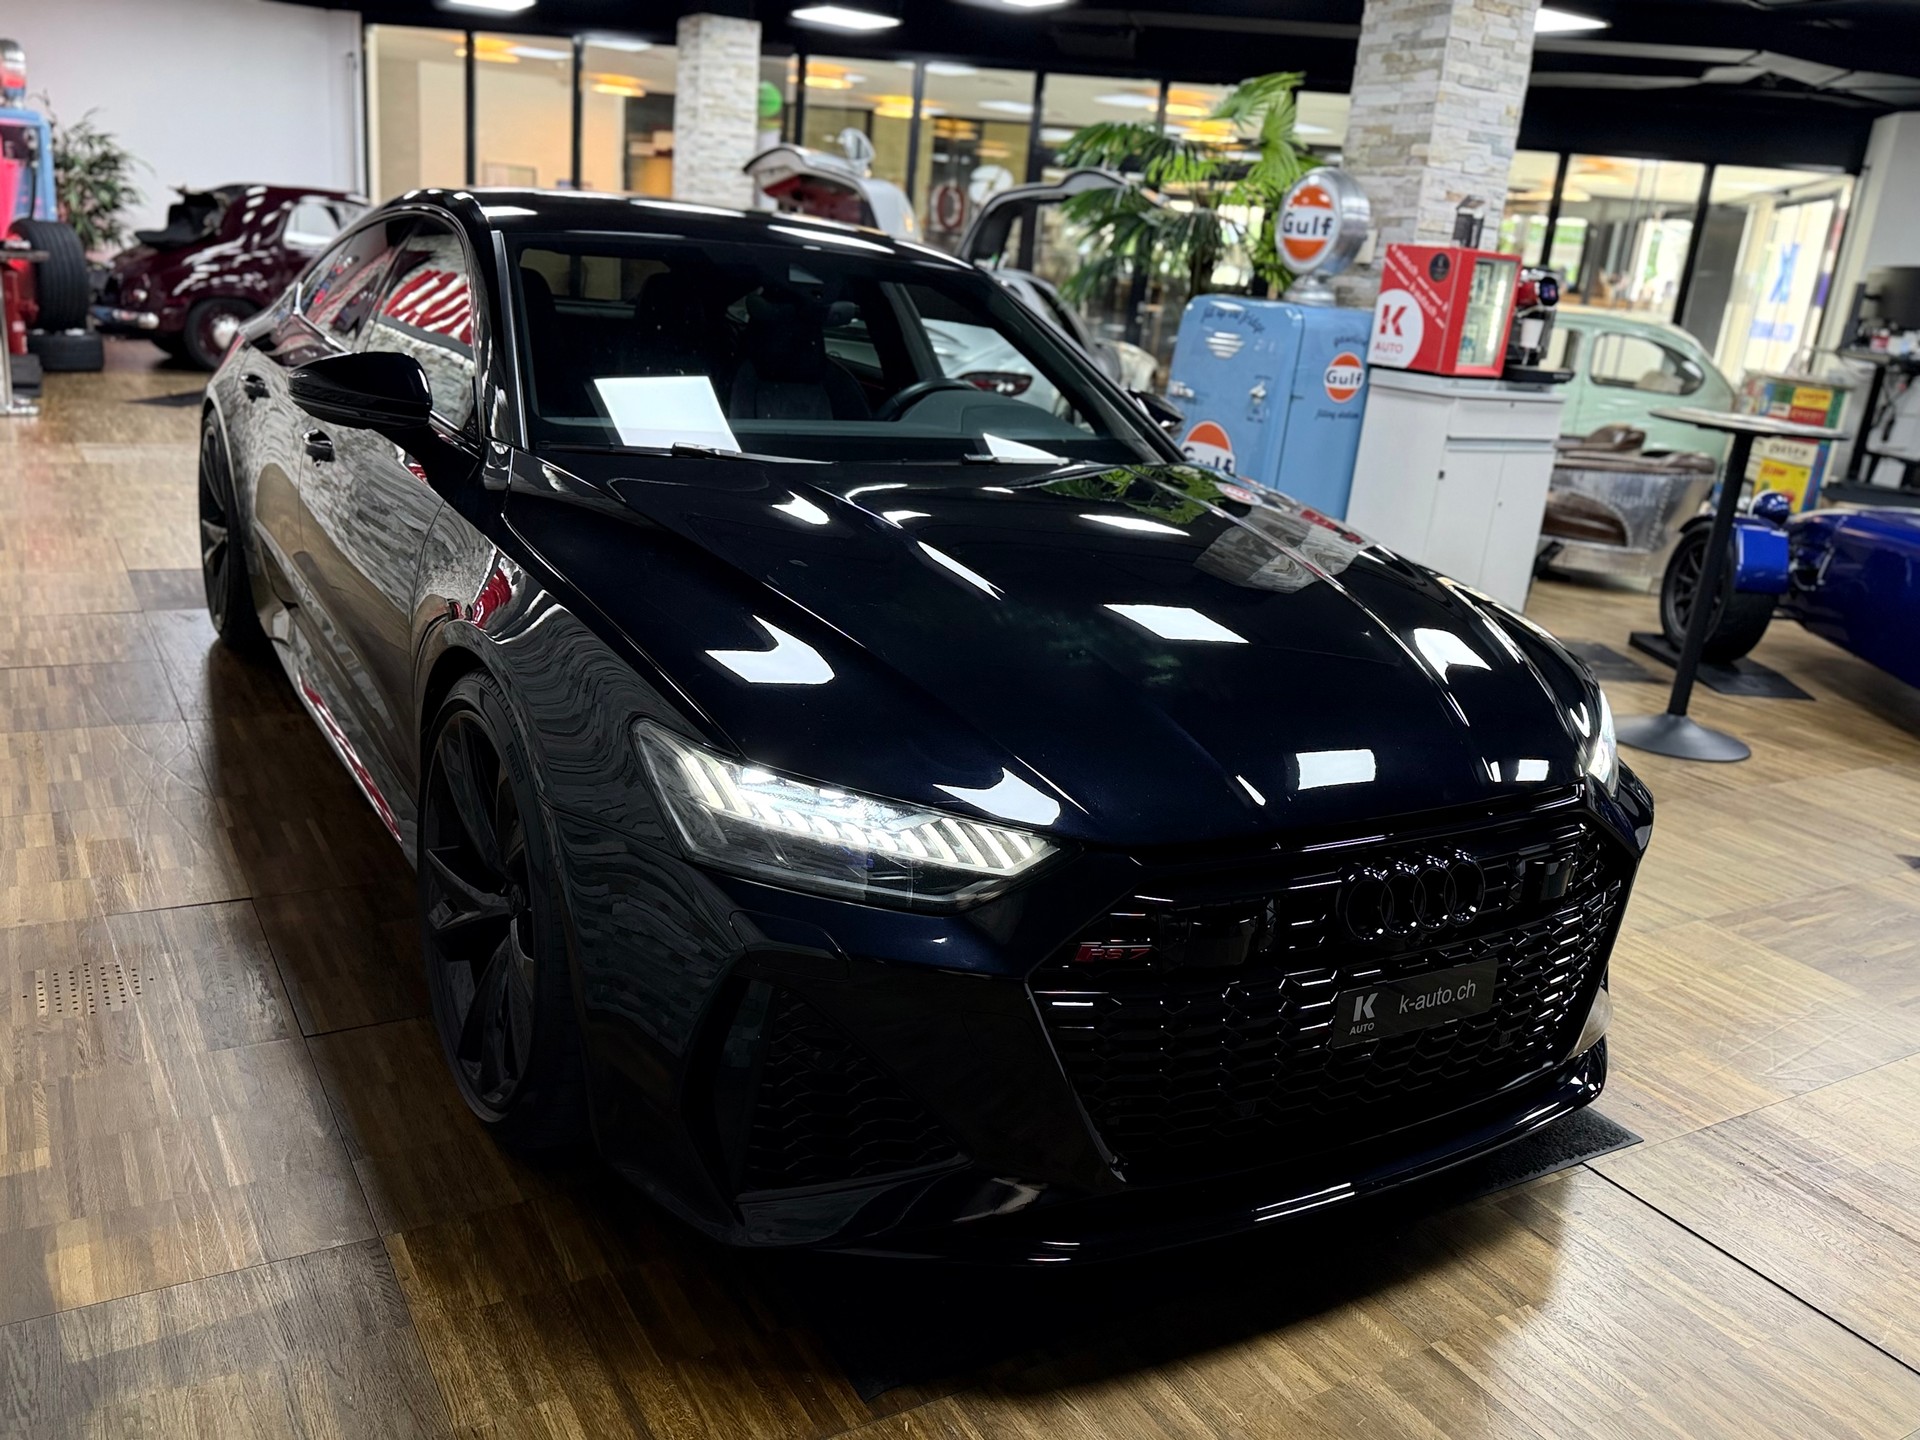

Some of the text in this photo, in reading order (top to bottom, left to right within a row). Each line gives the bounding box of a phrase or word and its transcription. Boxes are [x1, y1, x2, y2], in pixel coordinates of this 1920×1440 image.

[1283, 212, 1332, 235] Gulf
[1380, 304, 1407, 336] K
[1375, 342, 1403, 353] AUTO
[1326, 370, 1362, 385] Gulf
[1353, 992, 1378, 1022] K
[1399, 979, 1476, 1014] k-auto.ch
[1349, 1022, 1375, 1035] AUTO
